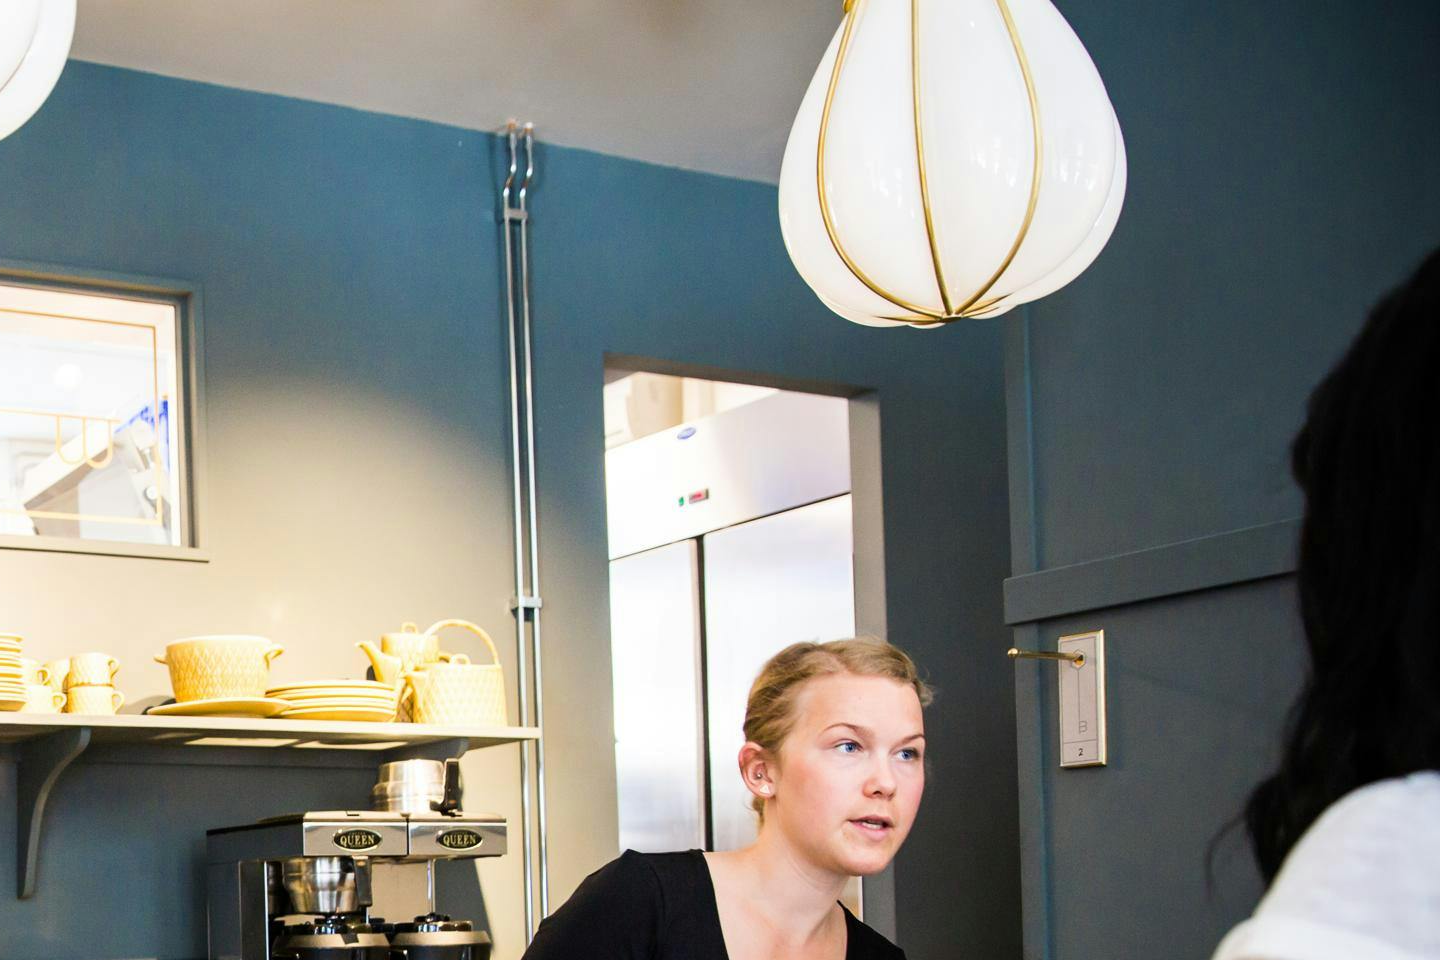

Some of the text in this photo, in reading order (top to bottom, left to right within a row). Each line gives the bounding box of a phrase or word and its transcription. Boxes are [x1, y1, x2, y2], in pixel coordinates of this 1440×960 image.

[1078, 747, 1084, 757] 2
[340, 835, 375, 848] QUEEN
[443, 834, 476, 847] QUEEN
